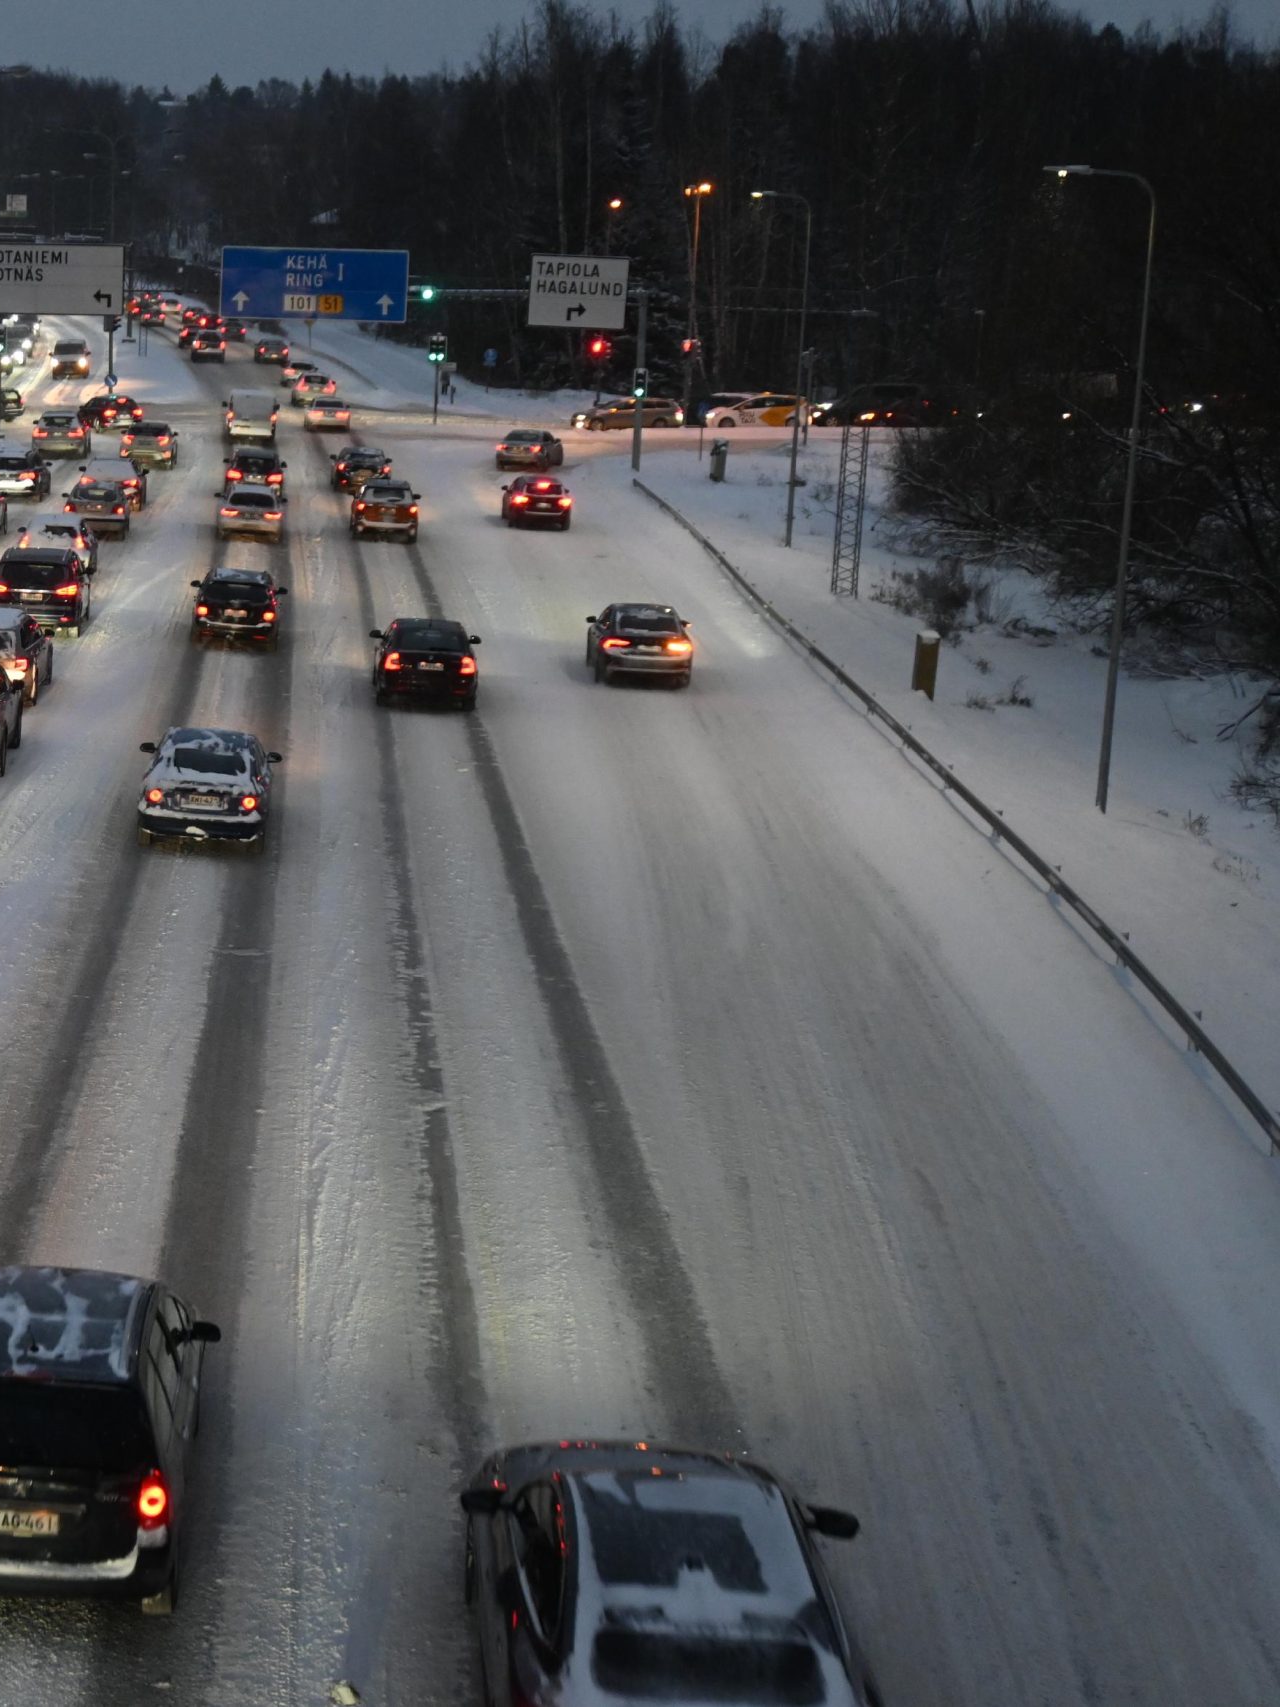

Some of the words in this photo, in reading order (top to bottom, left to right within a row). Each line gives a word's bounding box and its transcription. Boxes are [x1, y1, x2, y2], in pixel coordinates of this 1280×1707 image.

[286, 254, 328, 270] KEHÄ
[537, 261, 600, 278] TAPIOLA
[286, 273, 324, 287] RING
[536, 279, 624, 297] HAGALUND
[290, 296, 311, 311] 101
[323, 297, 339, 311] 51
